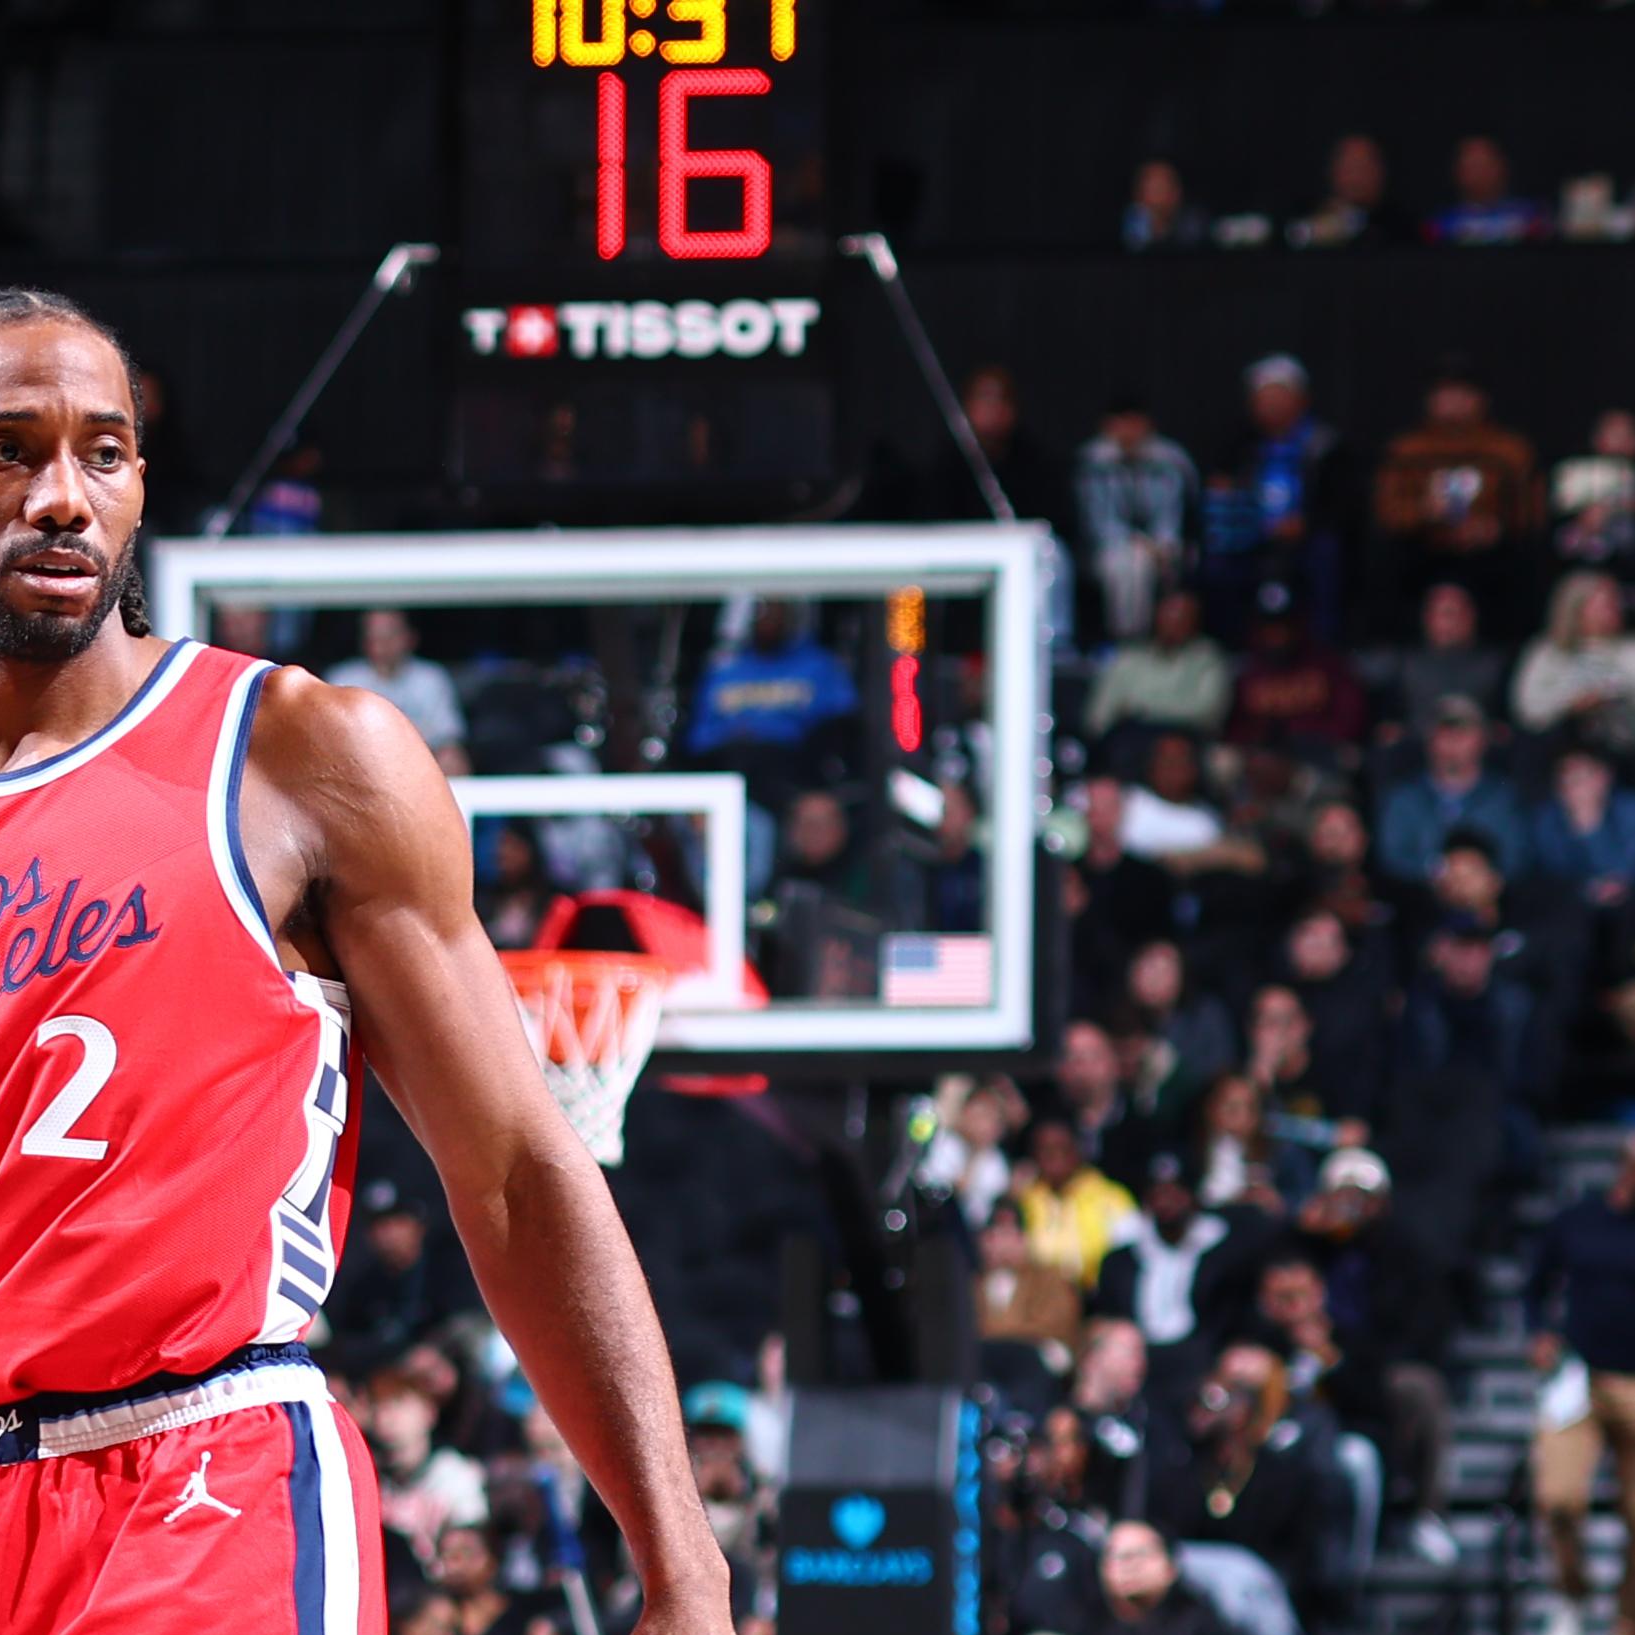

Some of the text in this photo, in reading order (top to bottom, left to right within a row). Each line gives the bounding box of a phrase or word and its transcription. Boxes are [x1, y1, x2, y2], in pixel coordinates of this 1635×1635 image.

[597, 68, 772, 260] 16
[559, 299, 820, 357] TISSOT
[20, 1015, 118, 1160] 2
[785, 1547, 933, 1586] BARCLAYS
